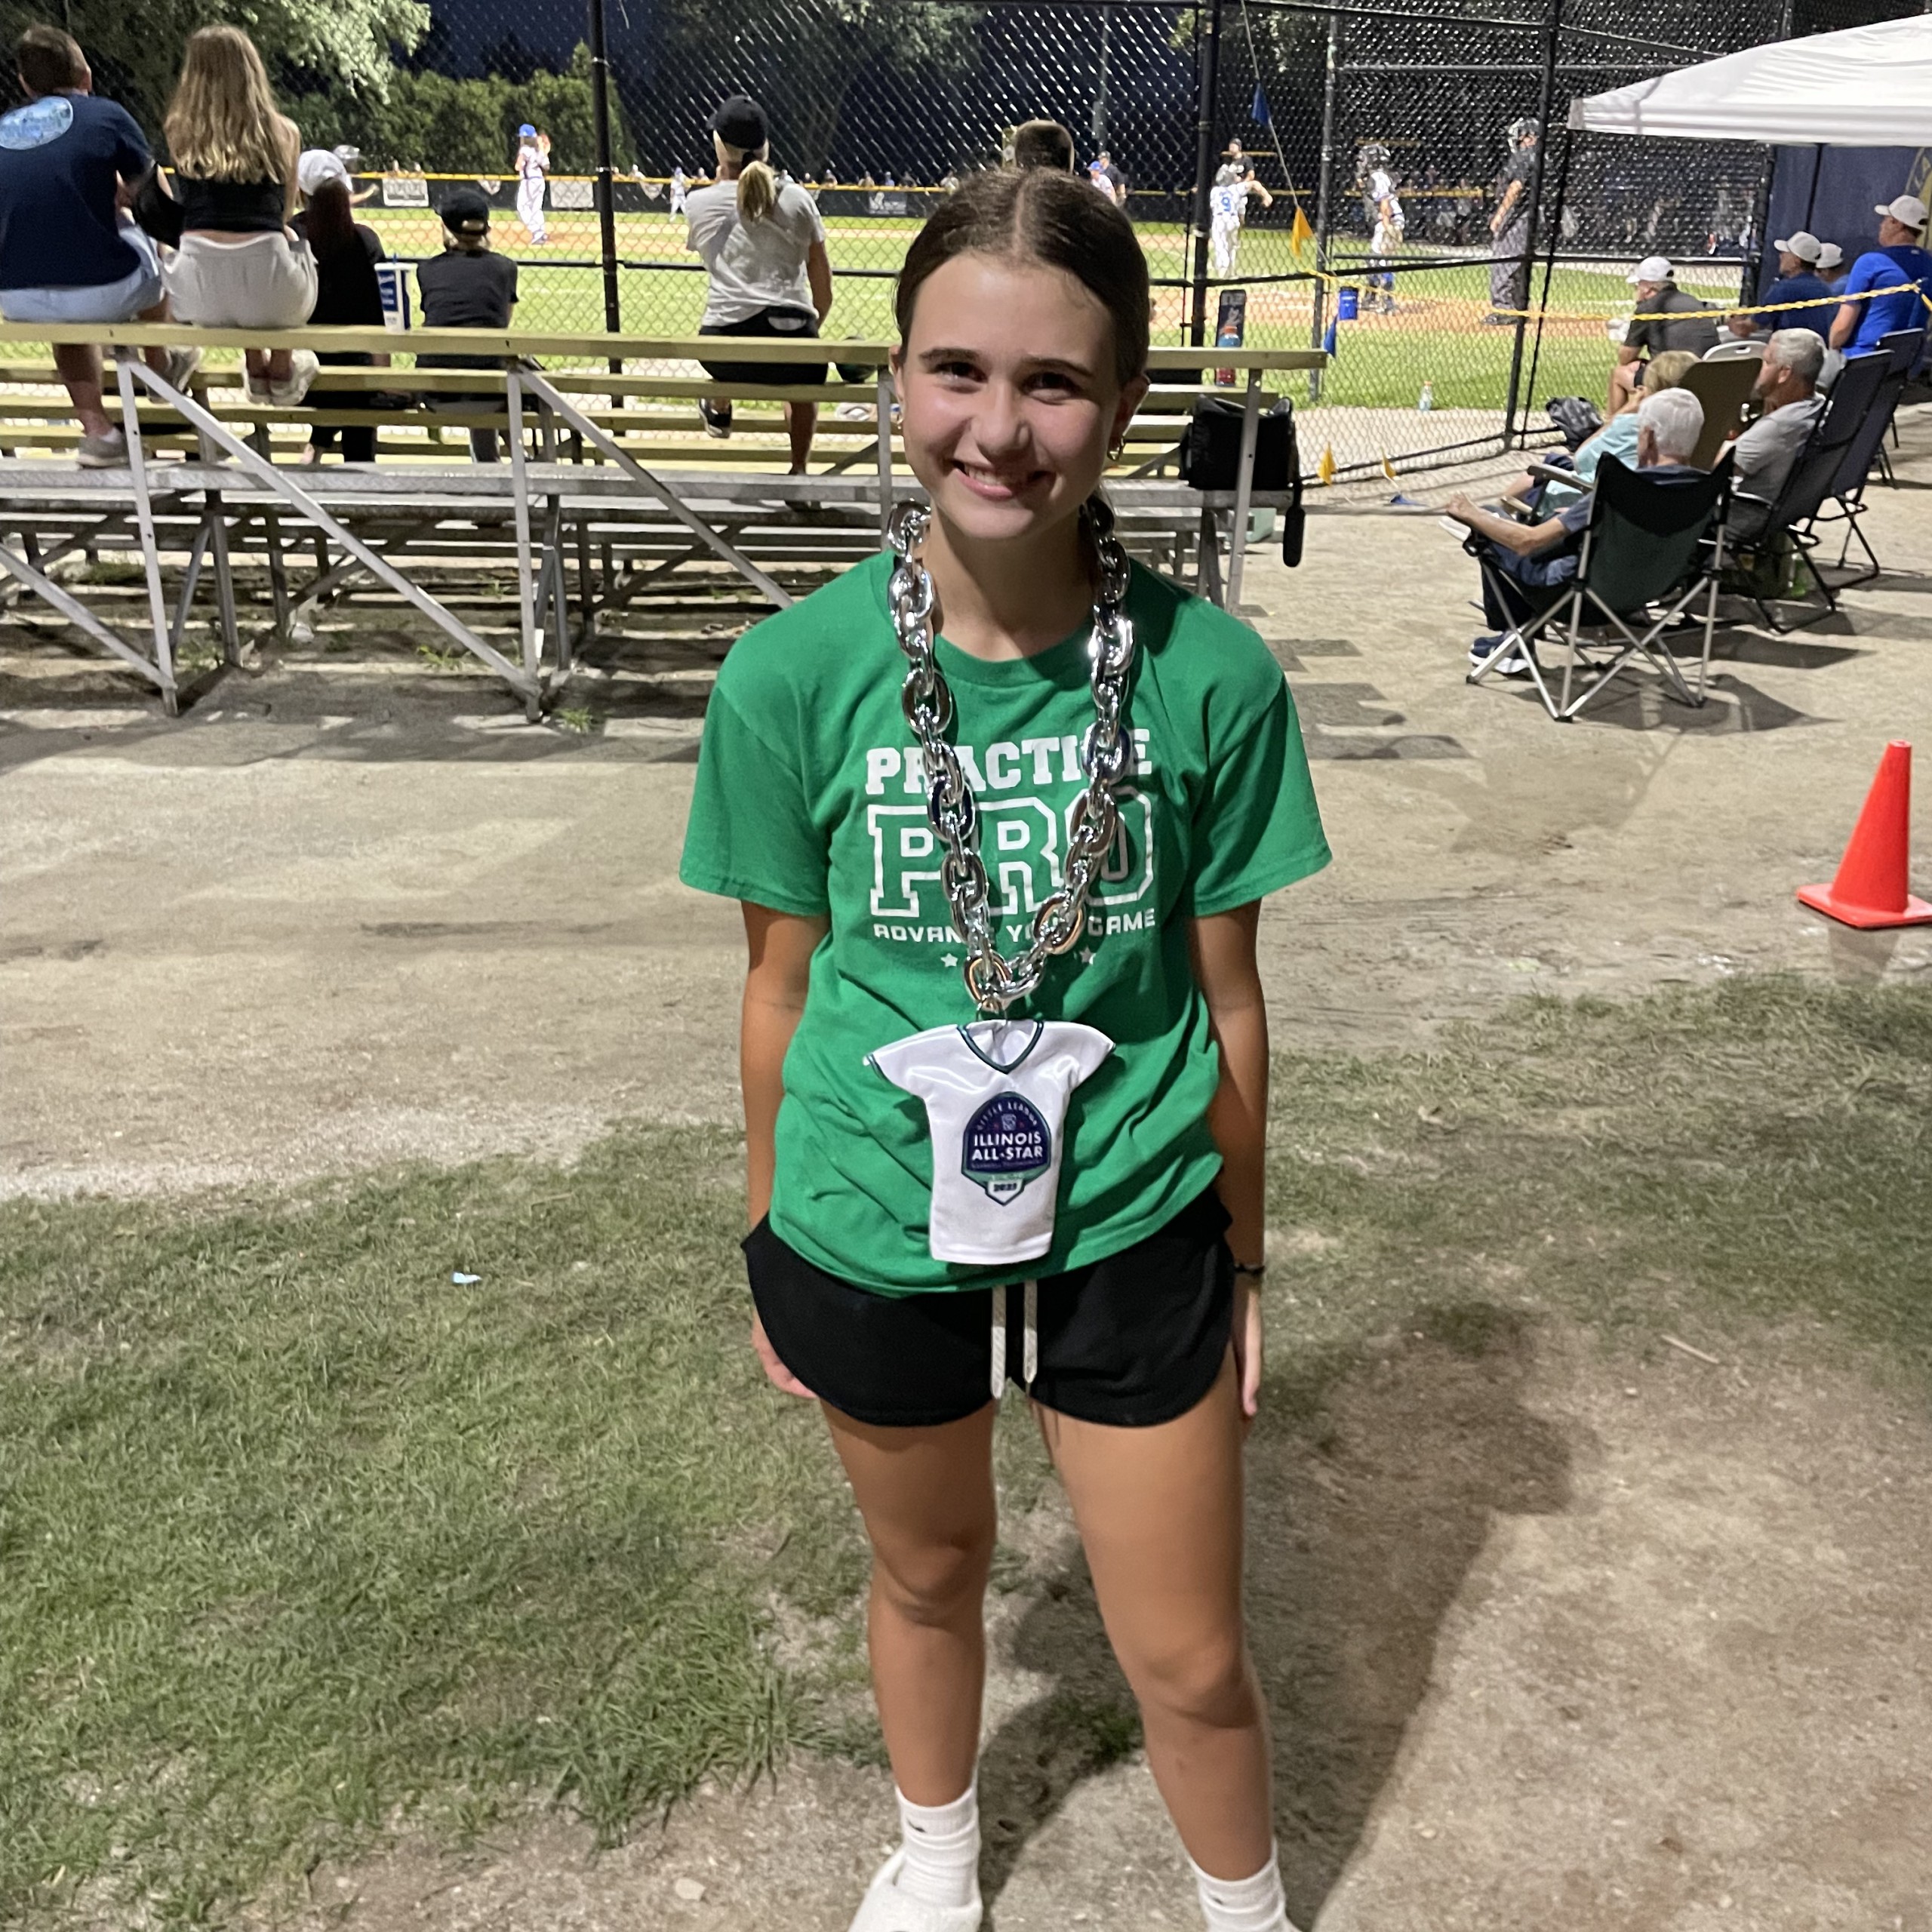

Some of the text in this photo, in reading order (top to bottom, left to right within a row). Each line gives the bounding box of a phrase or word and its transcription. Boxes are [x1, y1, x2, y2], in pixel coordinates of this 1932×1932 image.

[866, 728, 1152, 795] PRACTIE
[867, 786, 1155, 918] PRO
[1088, 908, 1155, 937] GAME
[974, 1131, 1041, 1146] ILLINOIS
